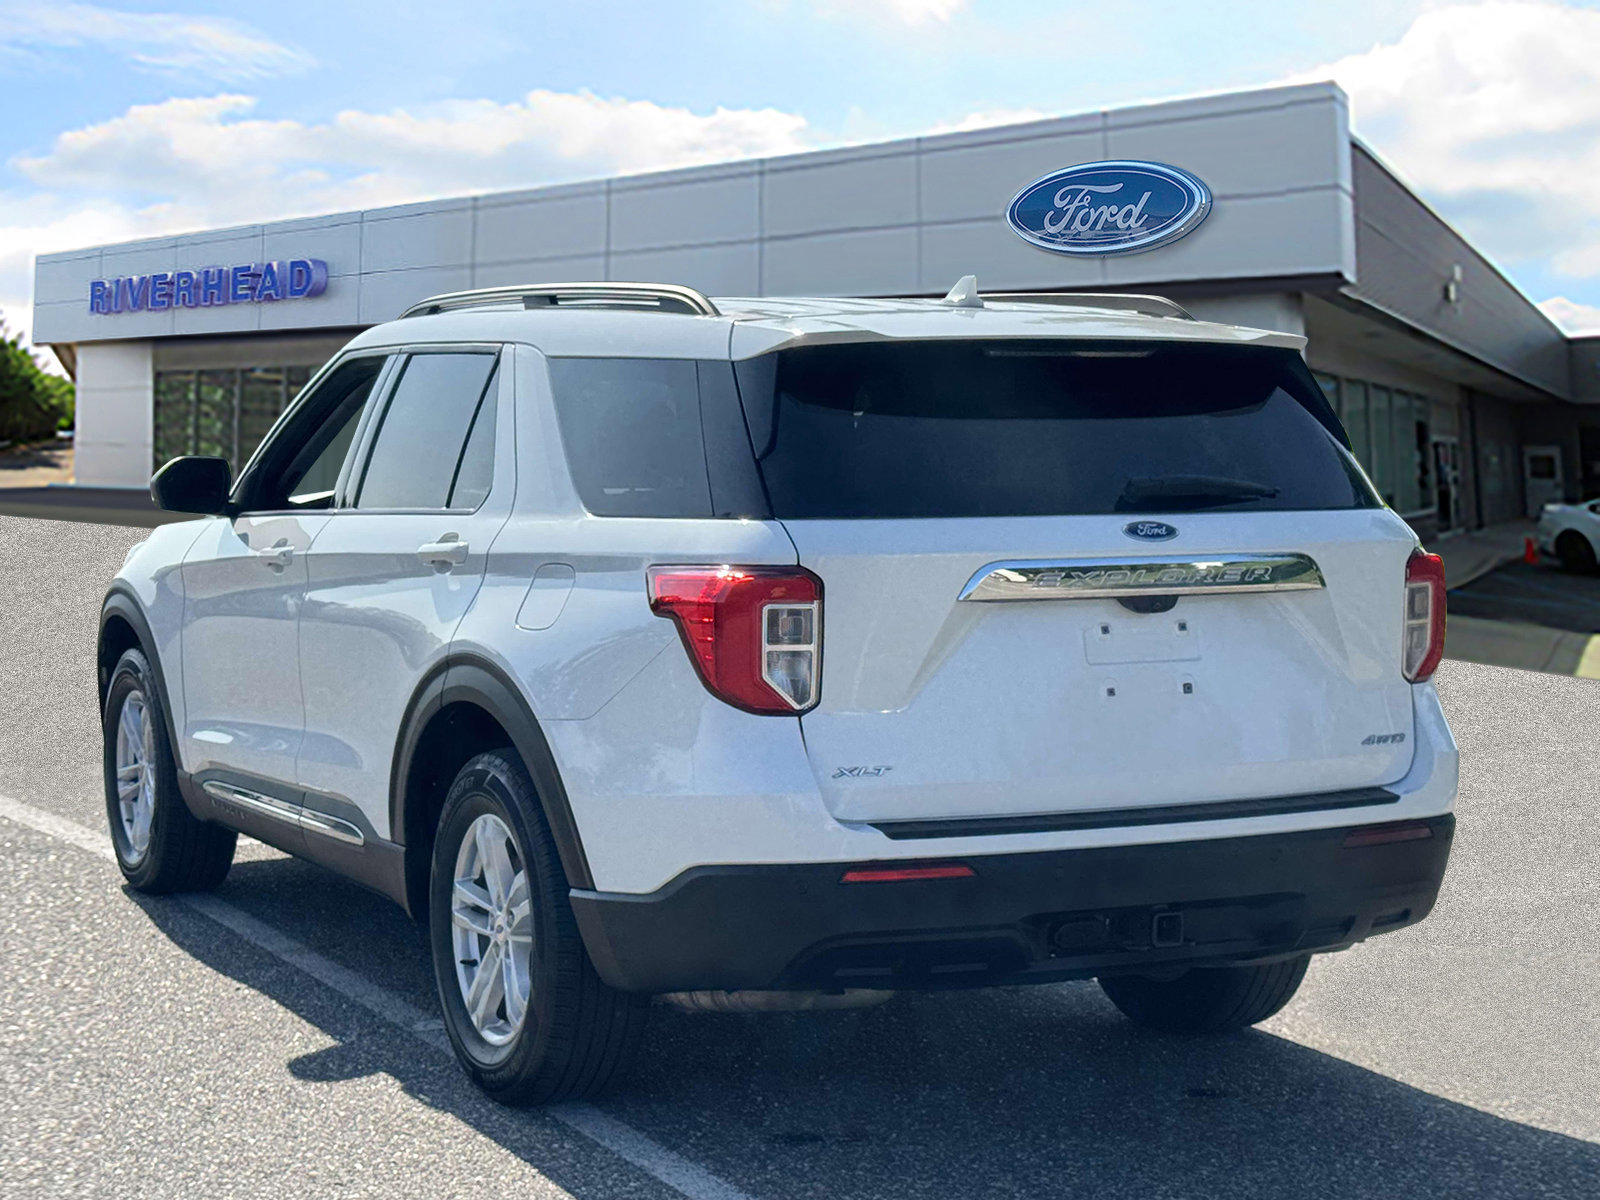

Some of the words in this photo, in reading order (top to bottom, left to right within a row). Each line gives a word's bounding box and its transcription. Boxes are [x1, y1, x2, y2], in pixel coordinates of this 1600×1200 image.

[1043, 183, 1152, 233] Ford
[89, 258, 318, 315] RIVERHEAD
[1136, 523, 1168, 536] Ford
[1032, 566, 1273, 589] EXPLORER
[831, 766, 893, 779] XLT
